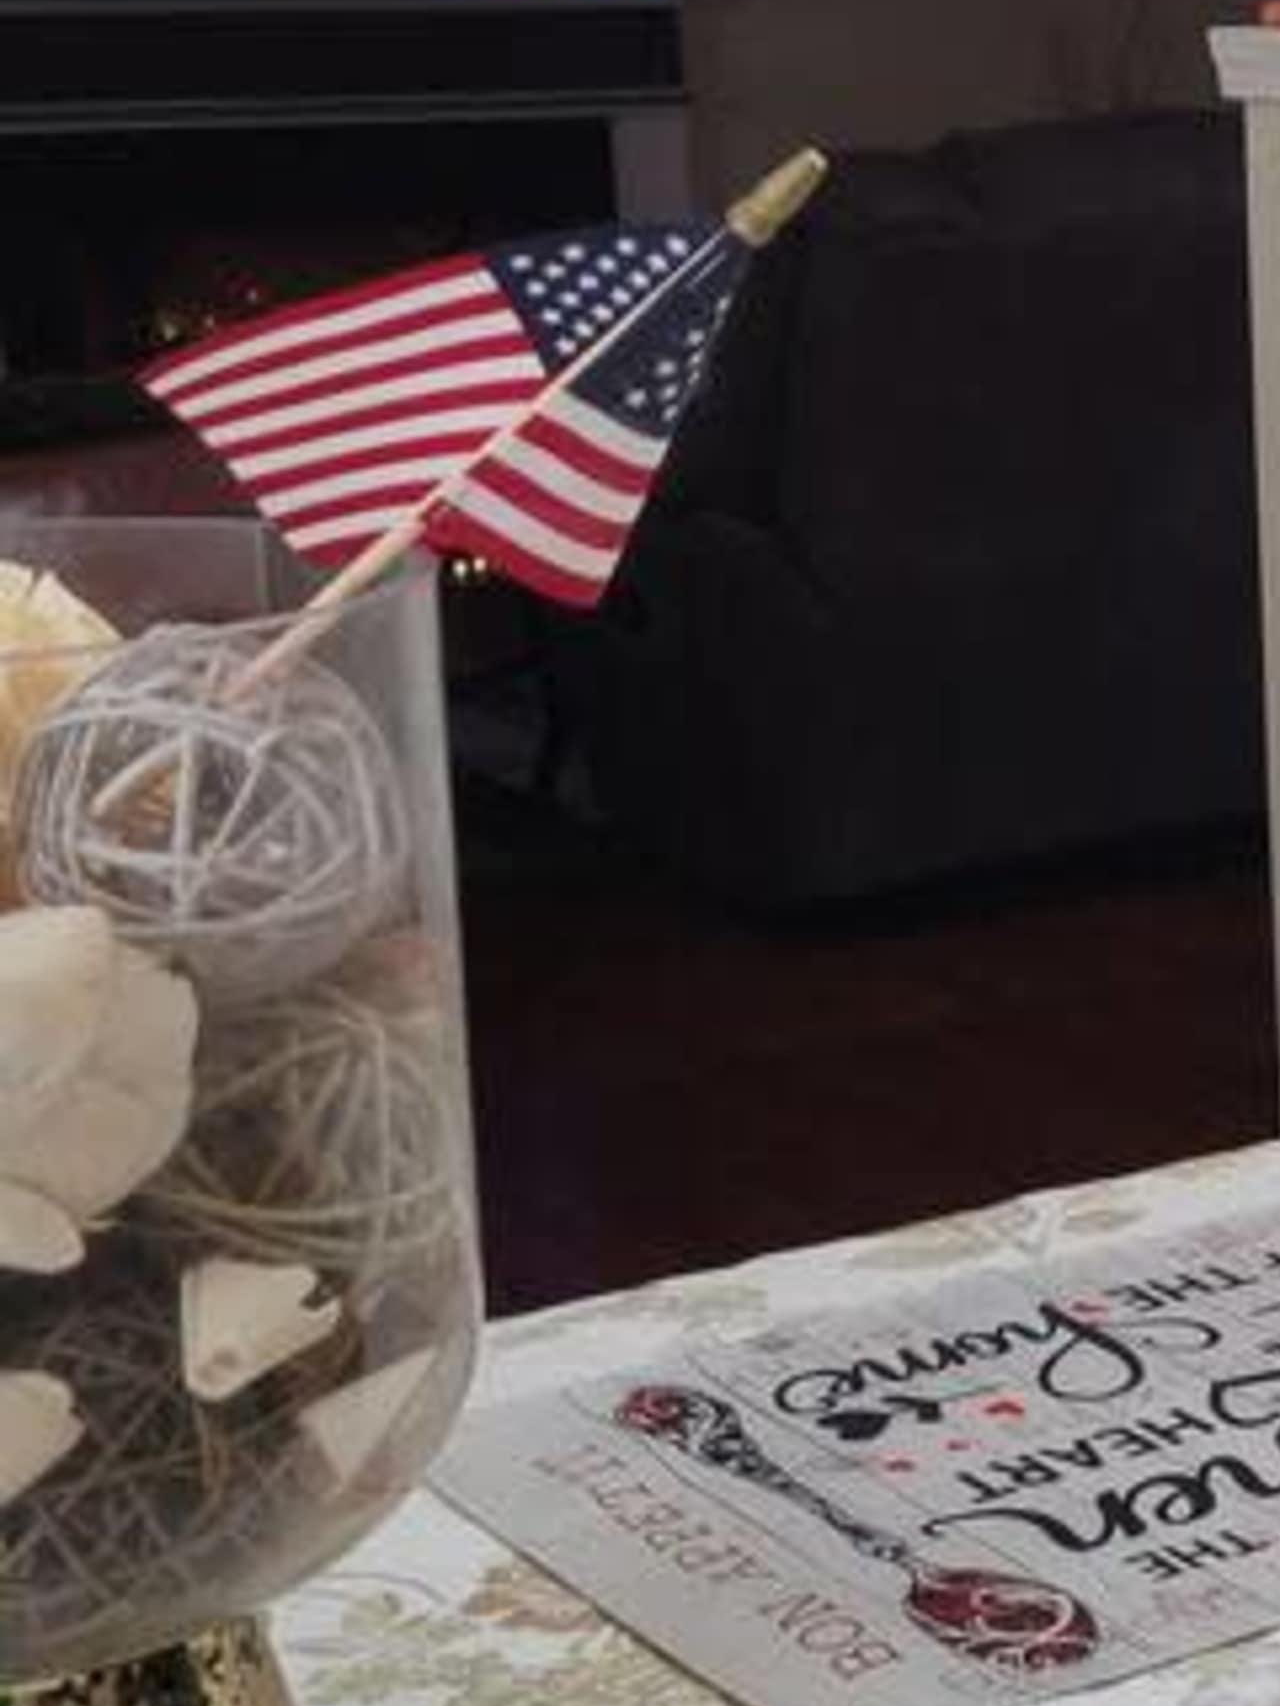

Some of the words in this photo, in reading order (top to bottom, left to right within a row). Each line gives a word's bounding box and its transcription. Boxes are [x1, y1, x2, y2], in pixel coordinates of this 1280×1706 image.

[1102, 1265, 1259, 1312] THE
[955, 1406, 1208, 1505] HEART
[1122, 1527, 1270, 1583] THE
[776, 1590, 904, 1682] BON
